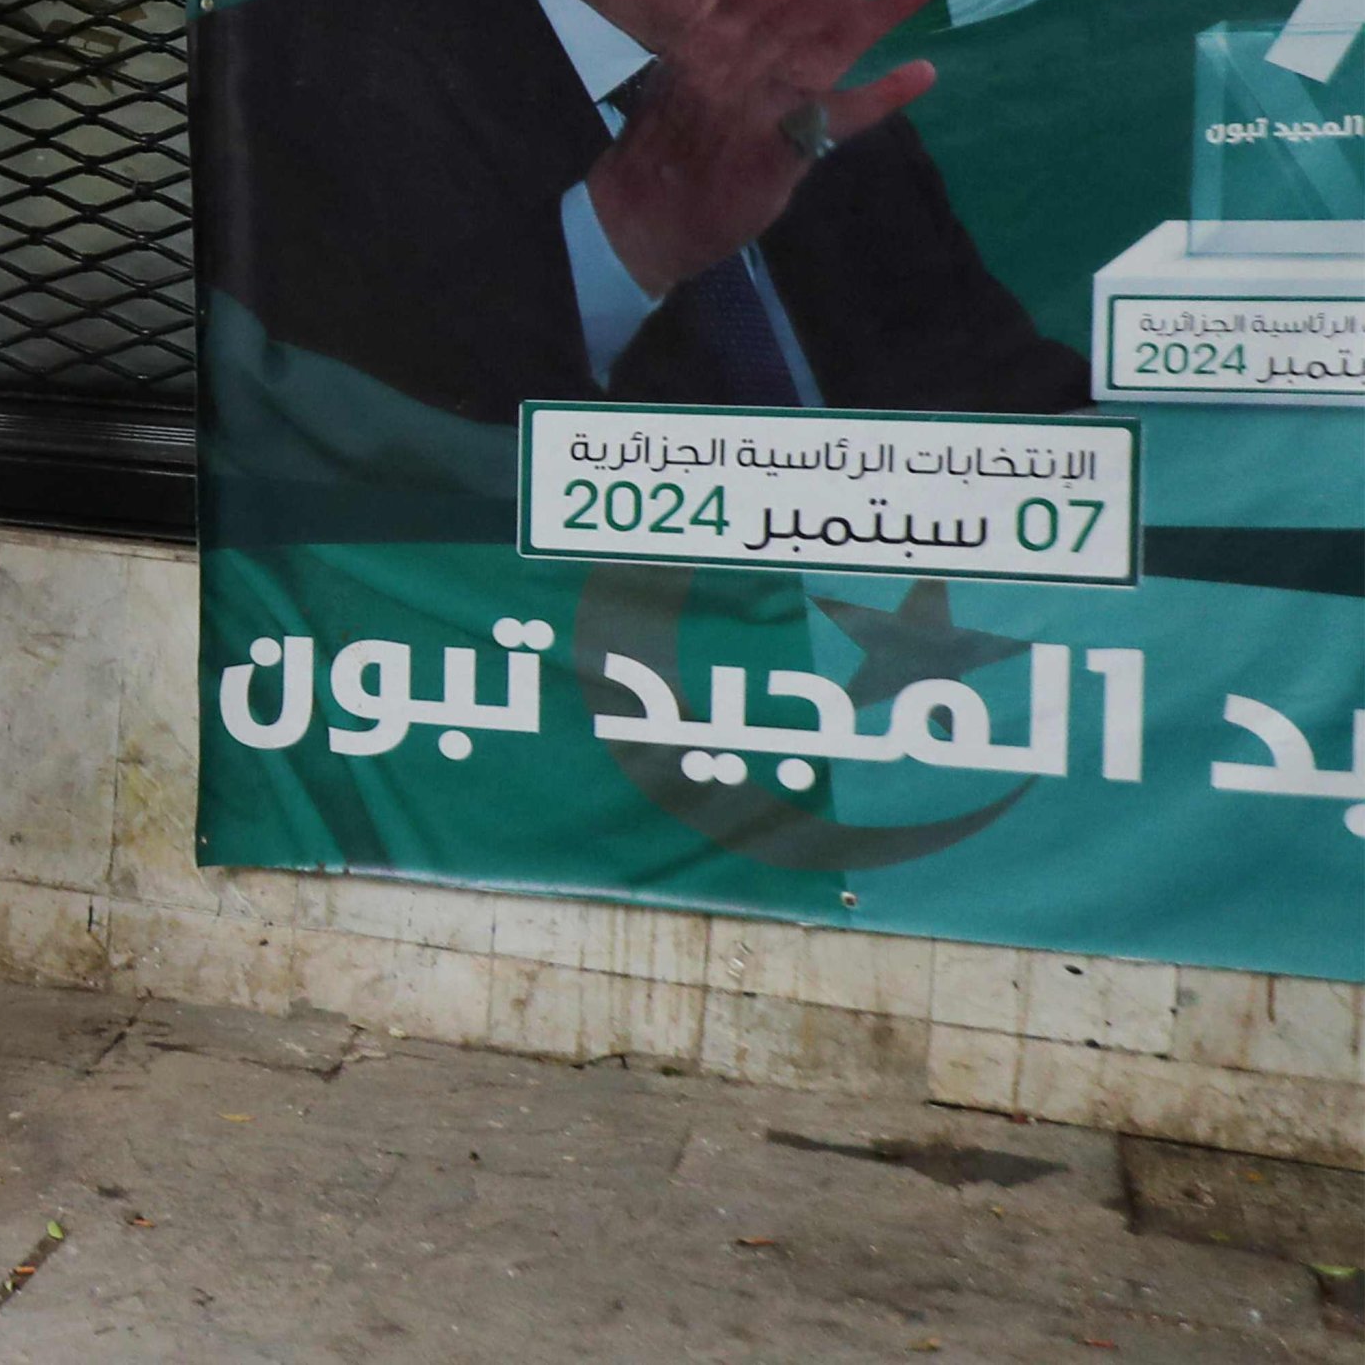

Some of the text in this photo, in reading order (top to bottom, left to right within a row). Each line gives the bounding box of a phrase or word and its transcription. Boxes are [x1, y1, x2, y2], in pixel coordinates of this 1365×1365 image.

[1205, 114, 1365, 145] المجيد تبون
[1139, 311, 1355, 338] الرئاسية الجزائرية
[1135, 341, 1247, 375] 2024
[568, 431, 726, 474] الجزائرية
[736, 438, 895, 478] الرئاسية
[562, 479, 1106, 559] 07 سبتمبر 2024
[219, 616, 556, 762] تبون
[593, 643, 1145, 792] المجيد
